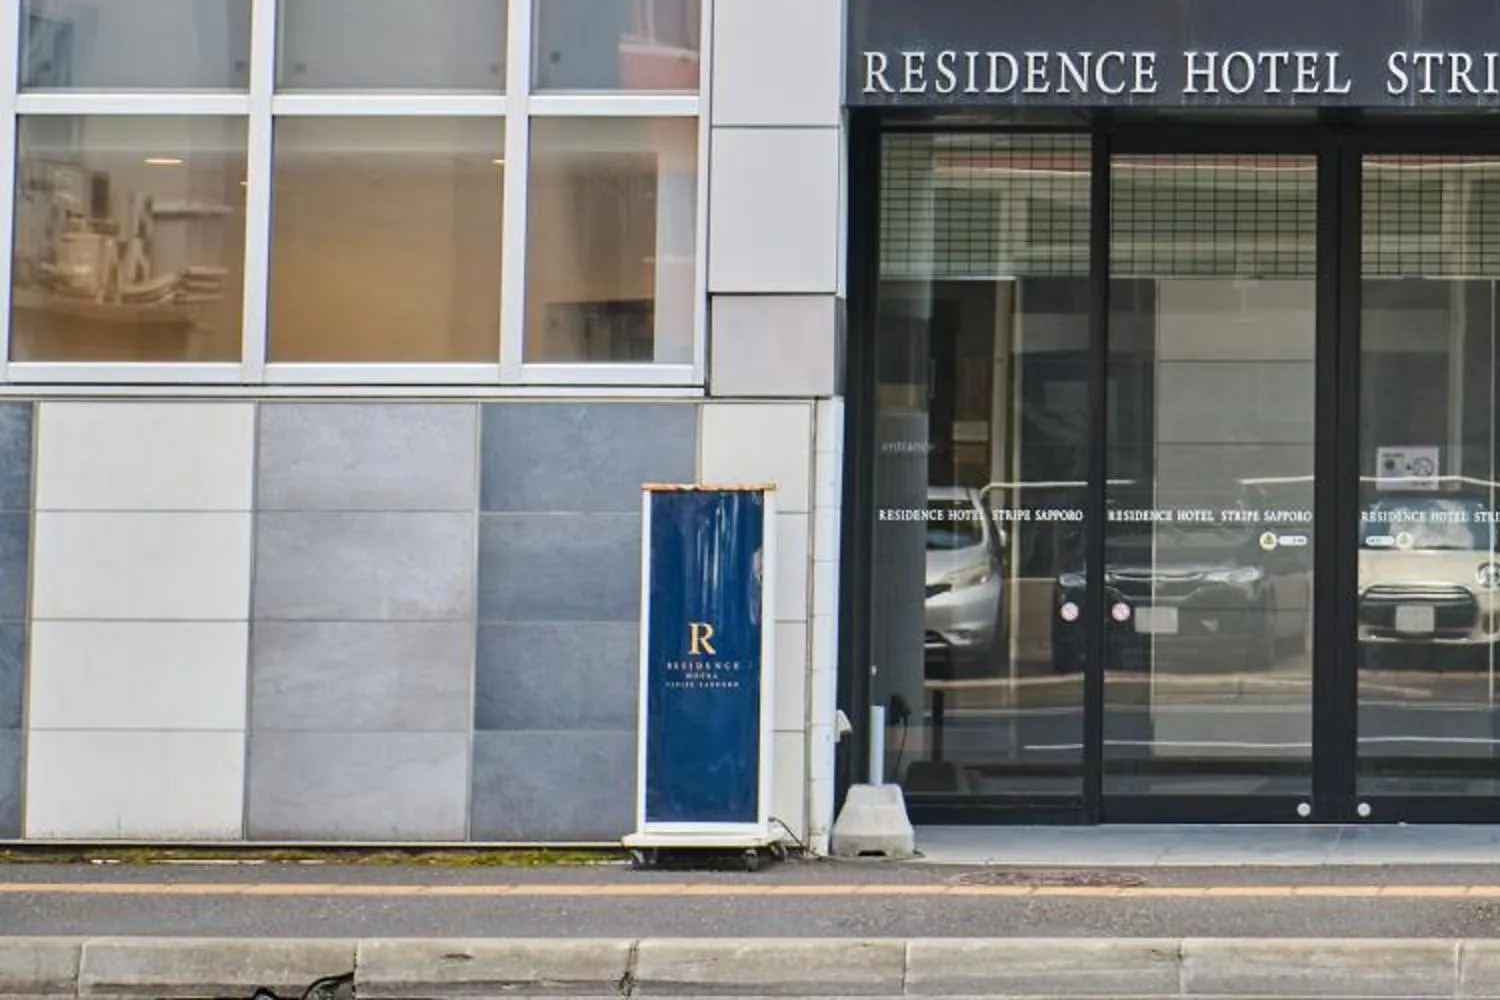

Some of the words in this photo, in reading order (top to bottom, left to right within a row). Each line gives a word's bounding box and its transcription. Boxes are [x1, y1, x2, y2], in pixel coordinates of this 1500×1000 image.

[861, 50, 1159, 94] RESIDENCE
[1182, 50, 1352, 95] HOTEL
[879, 509, 943, 521] RESIDENCE
[947, 509, 985, 521] HOTEL
[991, 509, 1030, 521] STRIPE
[1035, 509, 1084, 521] SAPPORO
[1107, 509, 1172, 522] RESIDENCE
[1177, 509, 1215, 522] HOTEL
[1220, 509, 1260, 522] STRIPE
[1263, 509, 1313, 522] SAPPORO
[1361, 511, 1425, 523] RESIDENCE
[1431, 511, 1466, 523] HOTEL
[687, 621, 717, 656] R
